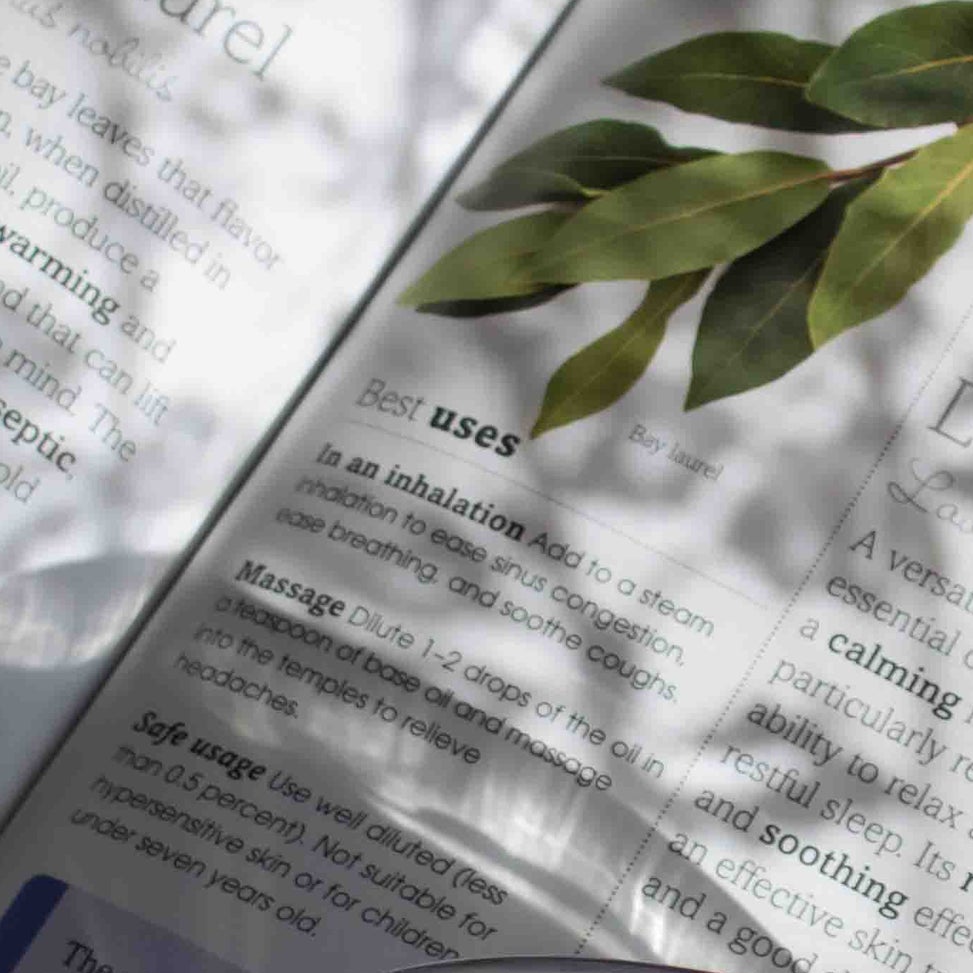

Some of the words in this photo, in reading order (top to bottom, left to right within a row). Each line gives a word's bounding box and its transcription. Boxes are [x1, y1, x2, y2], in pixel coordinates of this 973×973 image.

[20, 186, 139, 274] produce
[67, 93, 155, 166] leaves
[157, 157, 213, 208] that
[210, 198, 283, 271] flavor
[103, 179, 207, 266] distilled
[134, 383, 170, 426] lift
[355, 378, 425, 421] Best
[429, 406, 521, 458] uses
[628, 423, 668, 453] Bay
[667, 441, 725, 482] laurel
[328, 520, 439, 585] breathing,
[448, 575, 501, 608] and
[499, 599, 583, 650] soothe
[384, 464, 526, 541] inhalation
[527, 532, 587, 569] Add
[639, 588, 715, 637] steam
[849, 530, 877, 560] A
[430, 528, 488, 563] ease
[491, 556, 548, 593] sinus
[551, 585, 686, 667] congestion,
[826, 575, 961, 657] essential
[174, 651, 299, 720] headaches.
[235, 560, 346, 618] Massage
[348, 605, 415, 653] Dilute
[464, 664, 532, 708] drops
[565, 708, 606, 746] the
[799, 617, 820, 641] a
[828, 632, 963, 721] calming
[277, 655, 369, 709] temples
[400, 715, 481, 765] relieve
[453, 700, 507, 734] and
[505, 725, 613, 791] massage
[768, 659, 948, 767] particularly
[132, 711, 188, 747] Safe
[190, 737, 267, 781] usage
[315, 796, 367, 831] well
[366, 823, 457, 877] diluted
[720, 745, 821, 809] restful
[820, 798, 904, 858] sleep.
[913, 840, 956, 882] Its
[746, 702, 844, 767] ability
[846, 752, 880, 784] to
[883, 775, 965, 830] relax
[134, 836, 207, 878] seven
[204, 869, 276, 912] years
[313, 835, 362, 866] Not
[359, 863, 457, 921] suitable
[321, 883, 361, 912] for
[668, 833, 708, 866] an
[716, 856, 845, 938] effective
[694, 789, 760, 833] and
[759, 824, 910, 921] soothing
[641, 876, 707, 920] and
[706, 911, 728, 934] a
